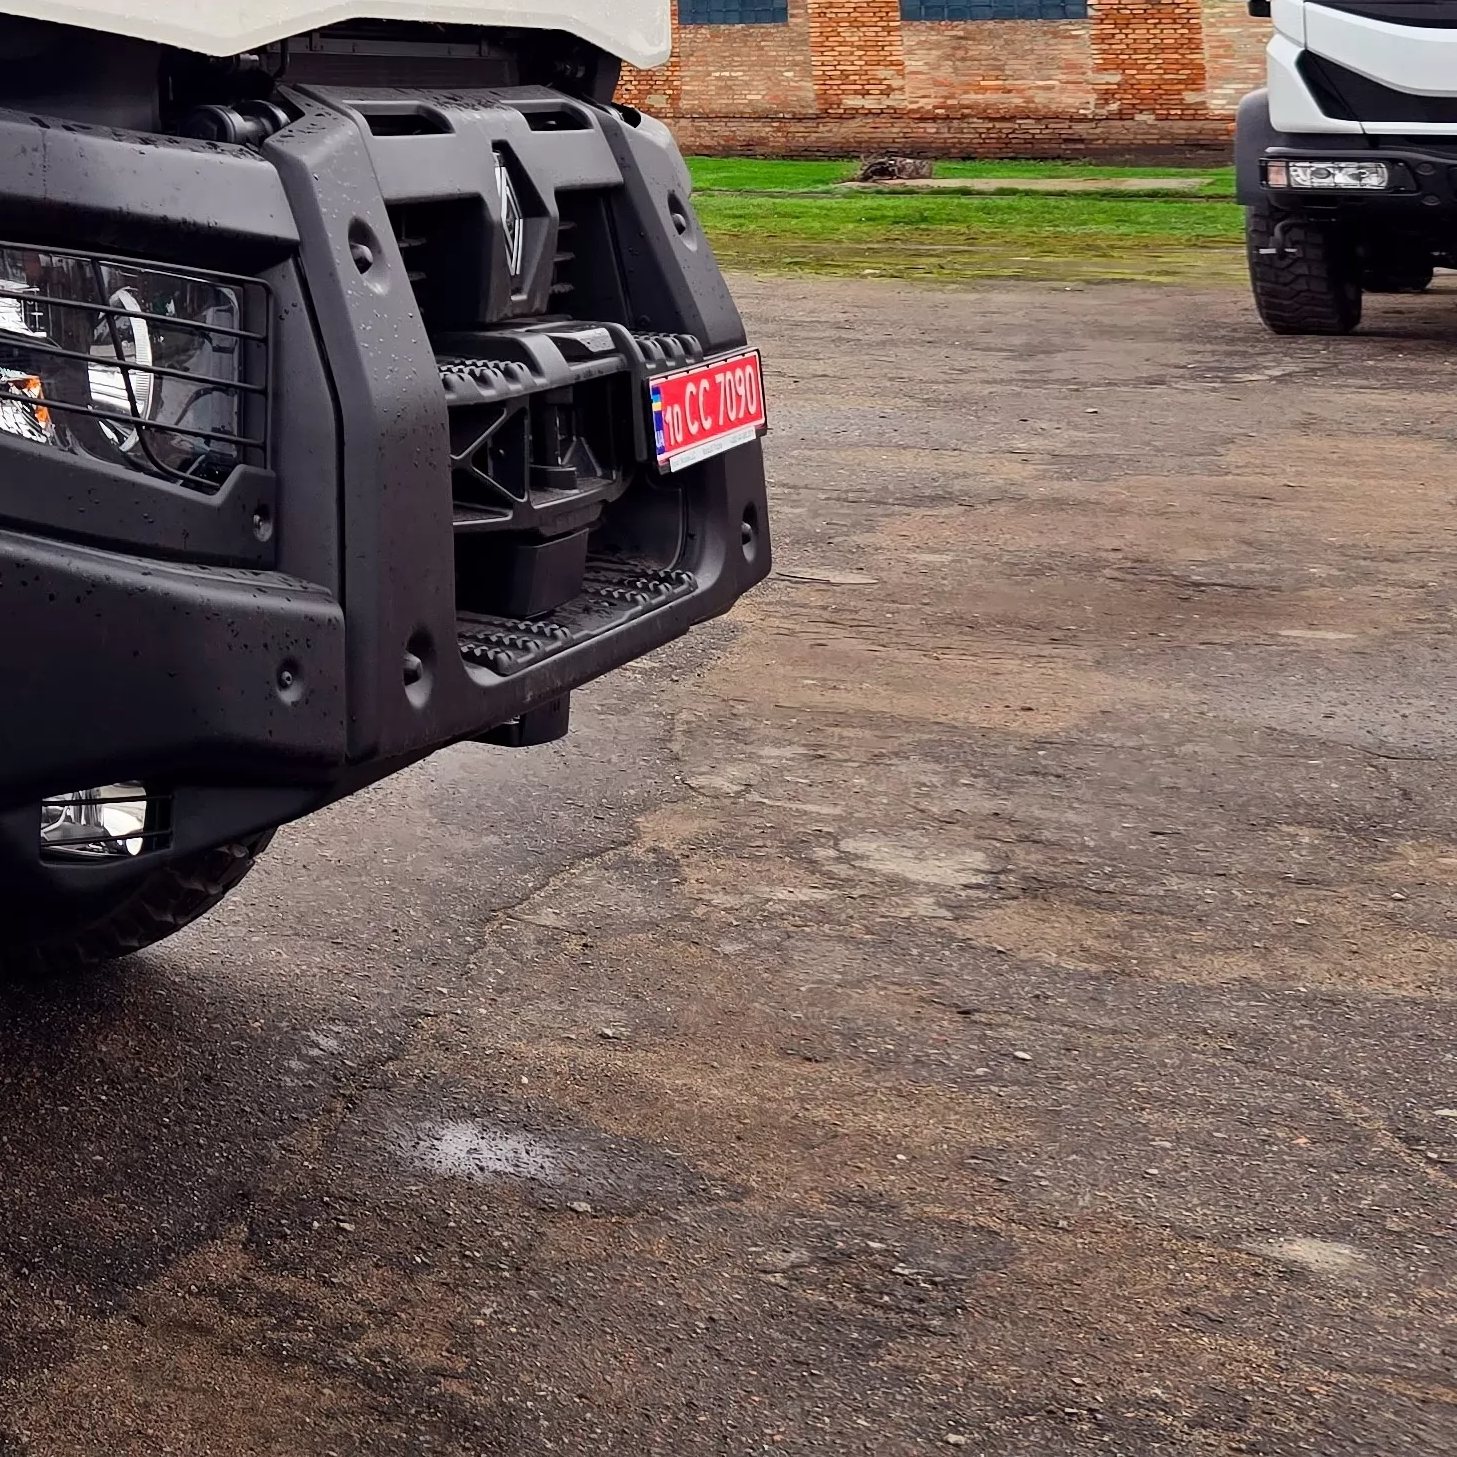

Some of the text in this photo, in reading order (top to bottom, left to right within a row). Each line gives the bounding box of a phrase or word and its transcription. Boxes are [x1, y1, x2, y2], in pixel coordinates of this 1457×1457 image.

[665, 364, 757, 446] 10 CC 7090
